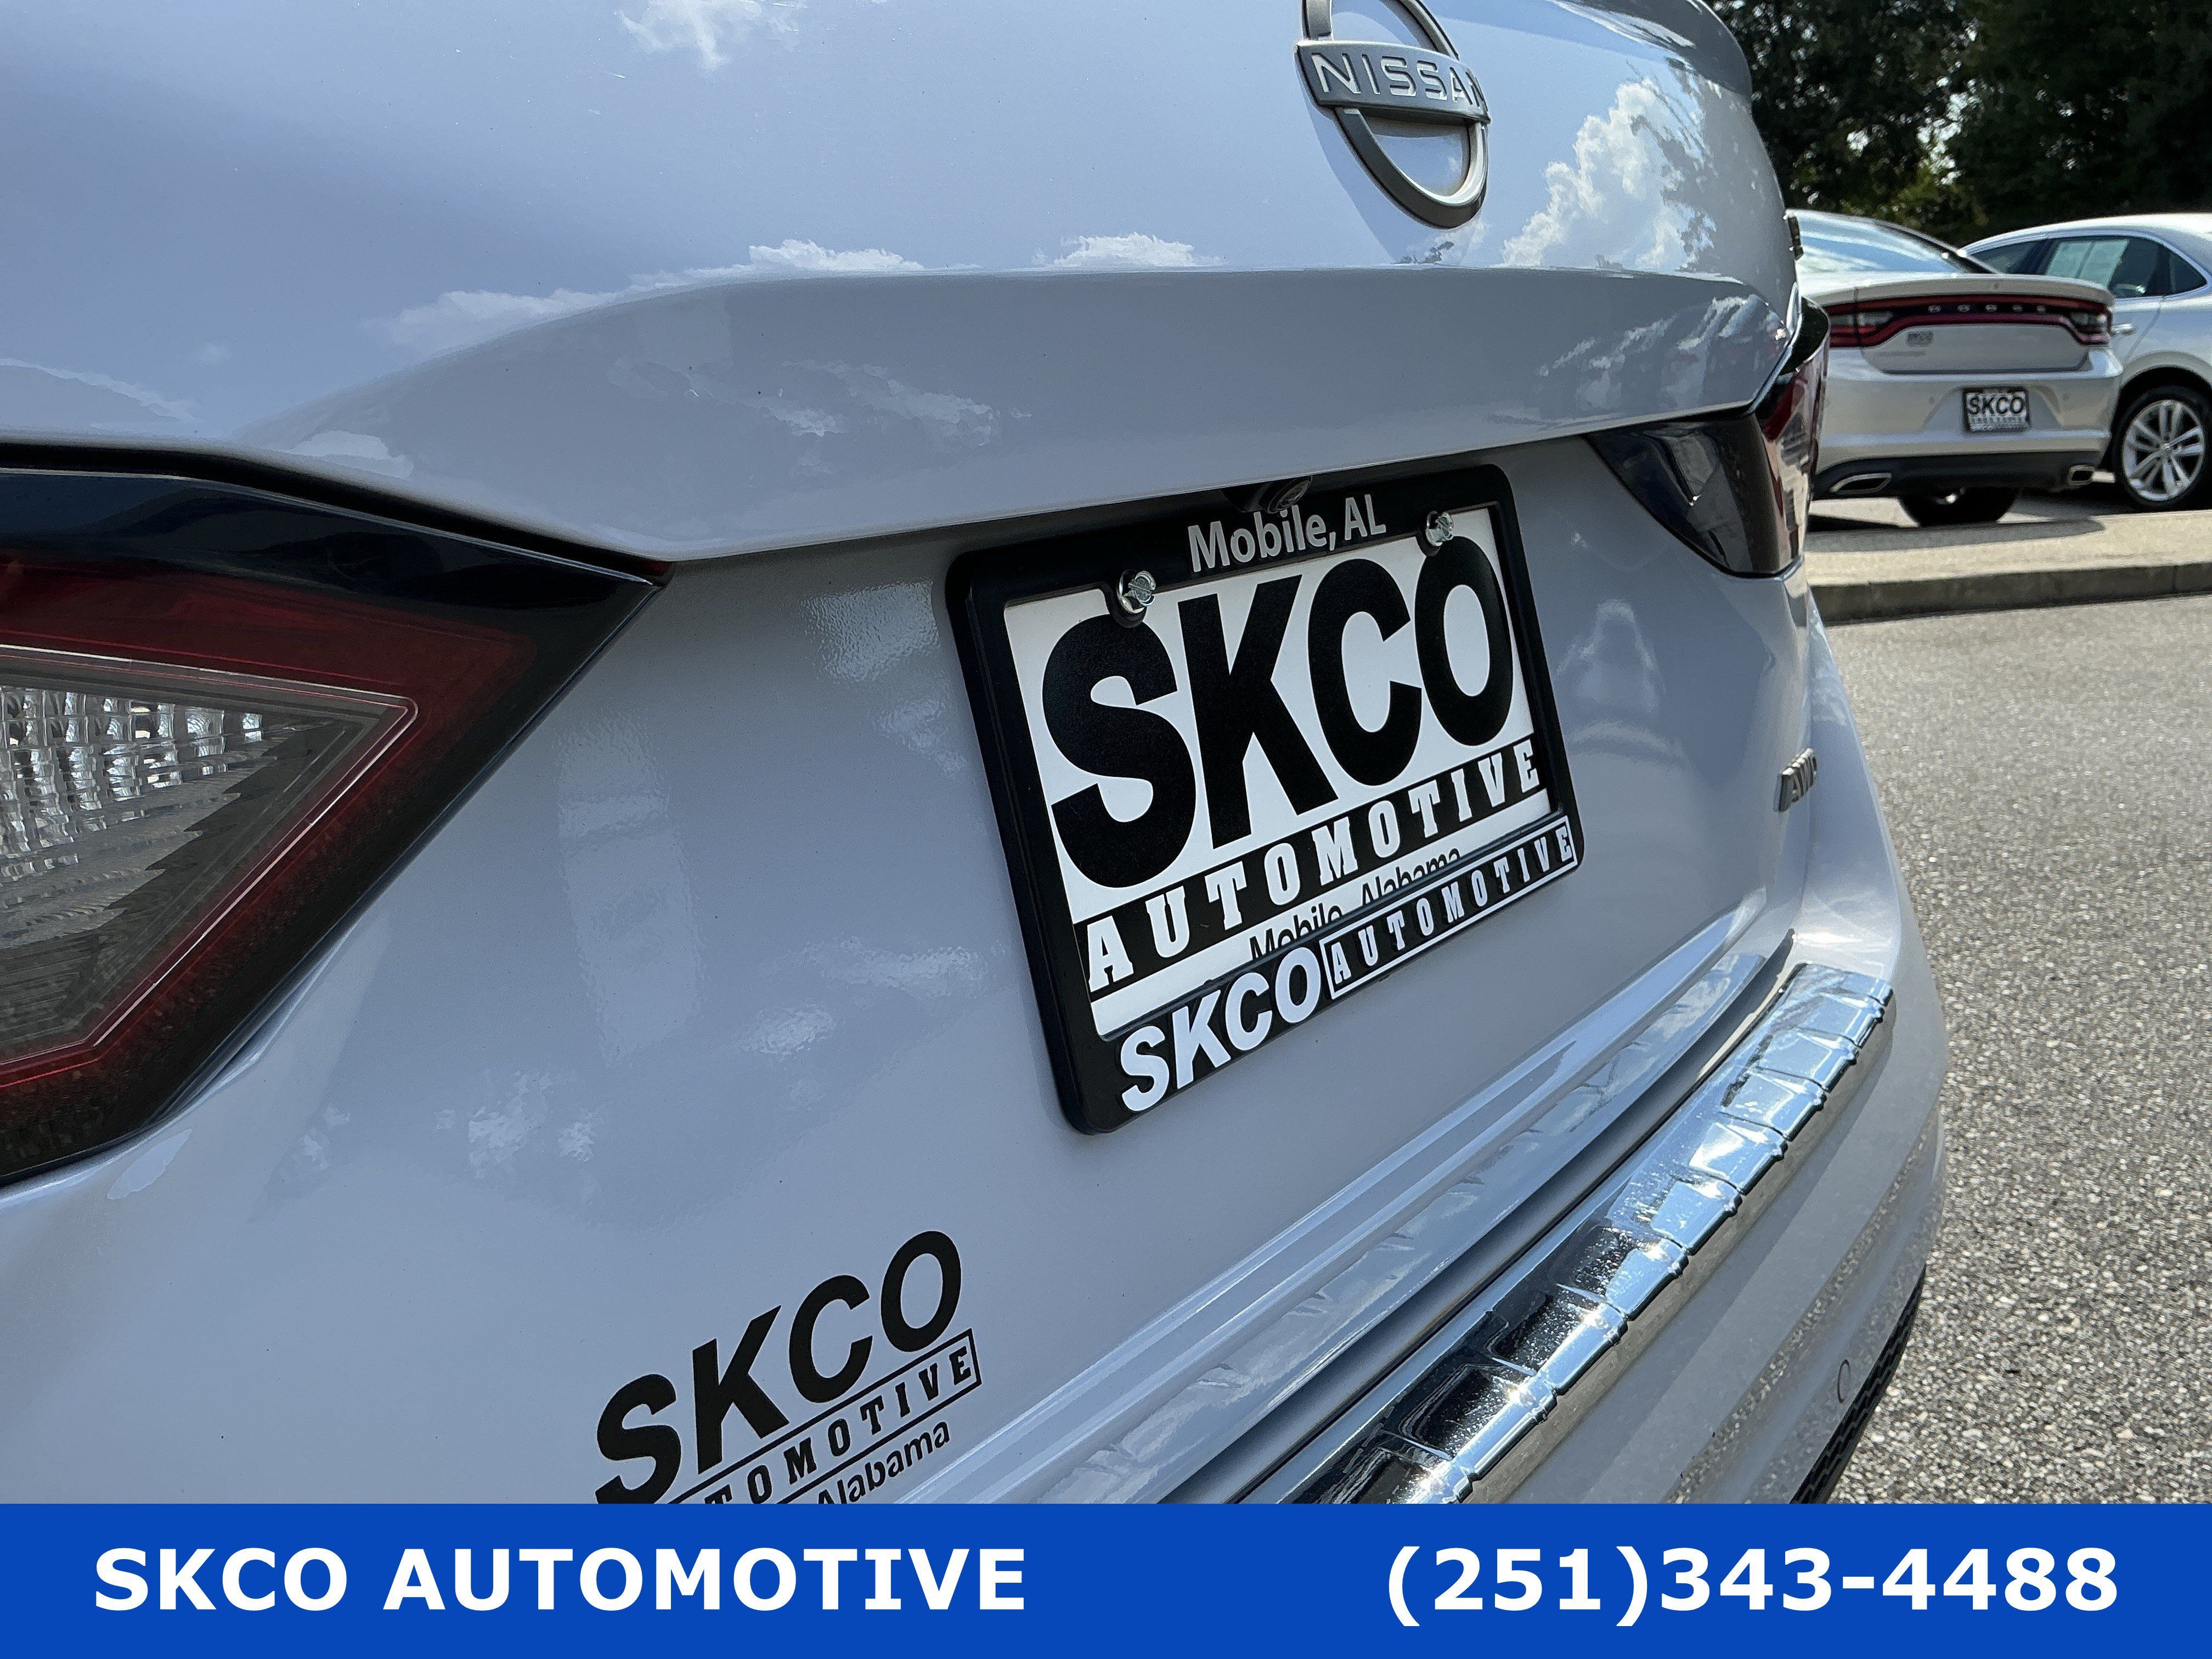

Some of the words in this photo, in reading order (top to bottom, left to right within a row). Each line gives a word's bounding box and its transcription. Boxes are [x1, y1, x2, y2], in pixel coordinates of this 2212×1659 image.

[1311, 53, 1486, 109] NISSAN
[1967, 397, 2025, 414] SKCO
[1188, 504, 1336, 572] Mobile,
[1344, 494, 1387, 541] AL
[1042, 535, 1514, 889] SKCO
[1088, 739, 1541, 992] AUTOMOTIVE
[1120, 947, 1322, 1113] SKCO
[1331, 826, 1573, 984] AUTOMOTIVE
[595, 1231, 962, 1504] SKCO
